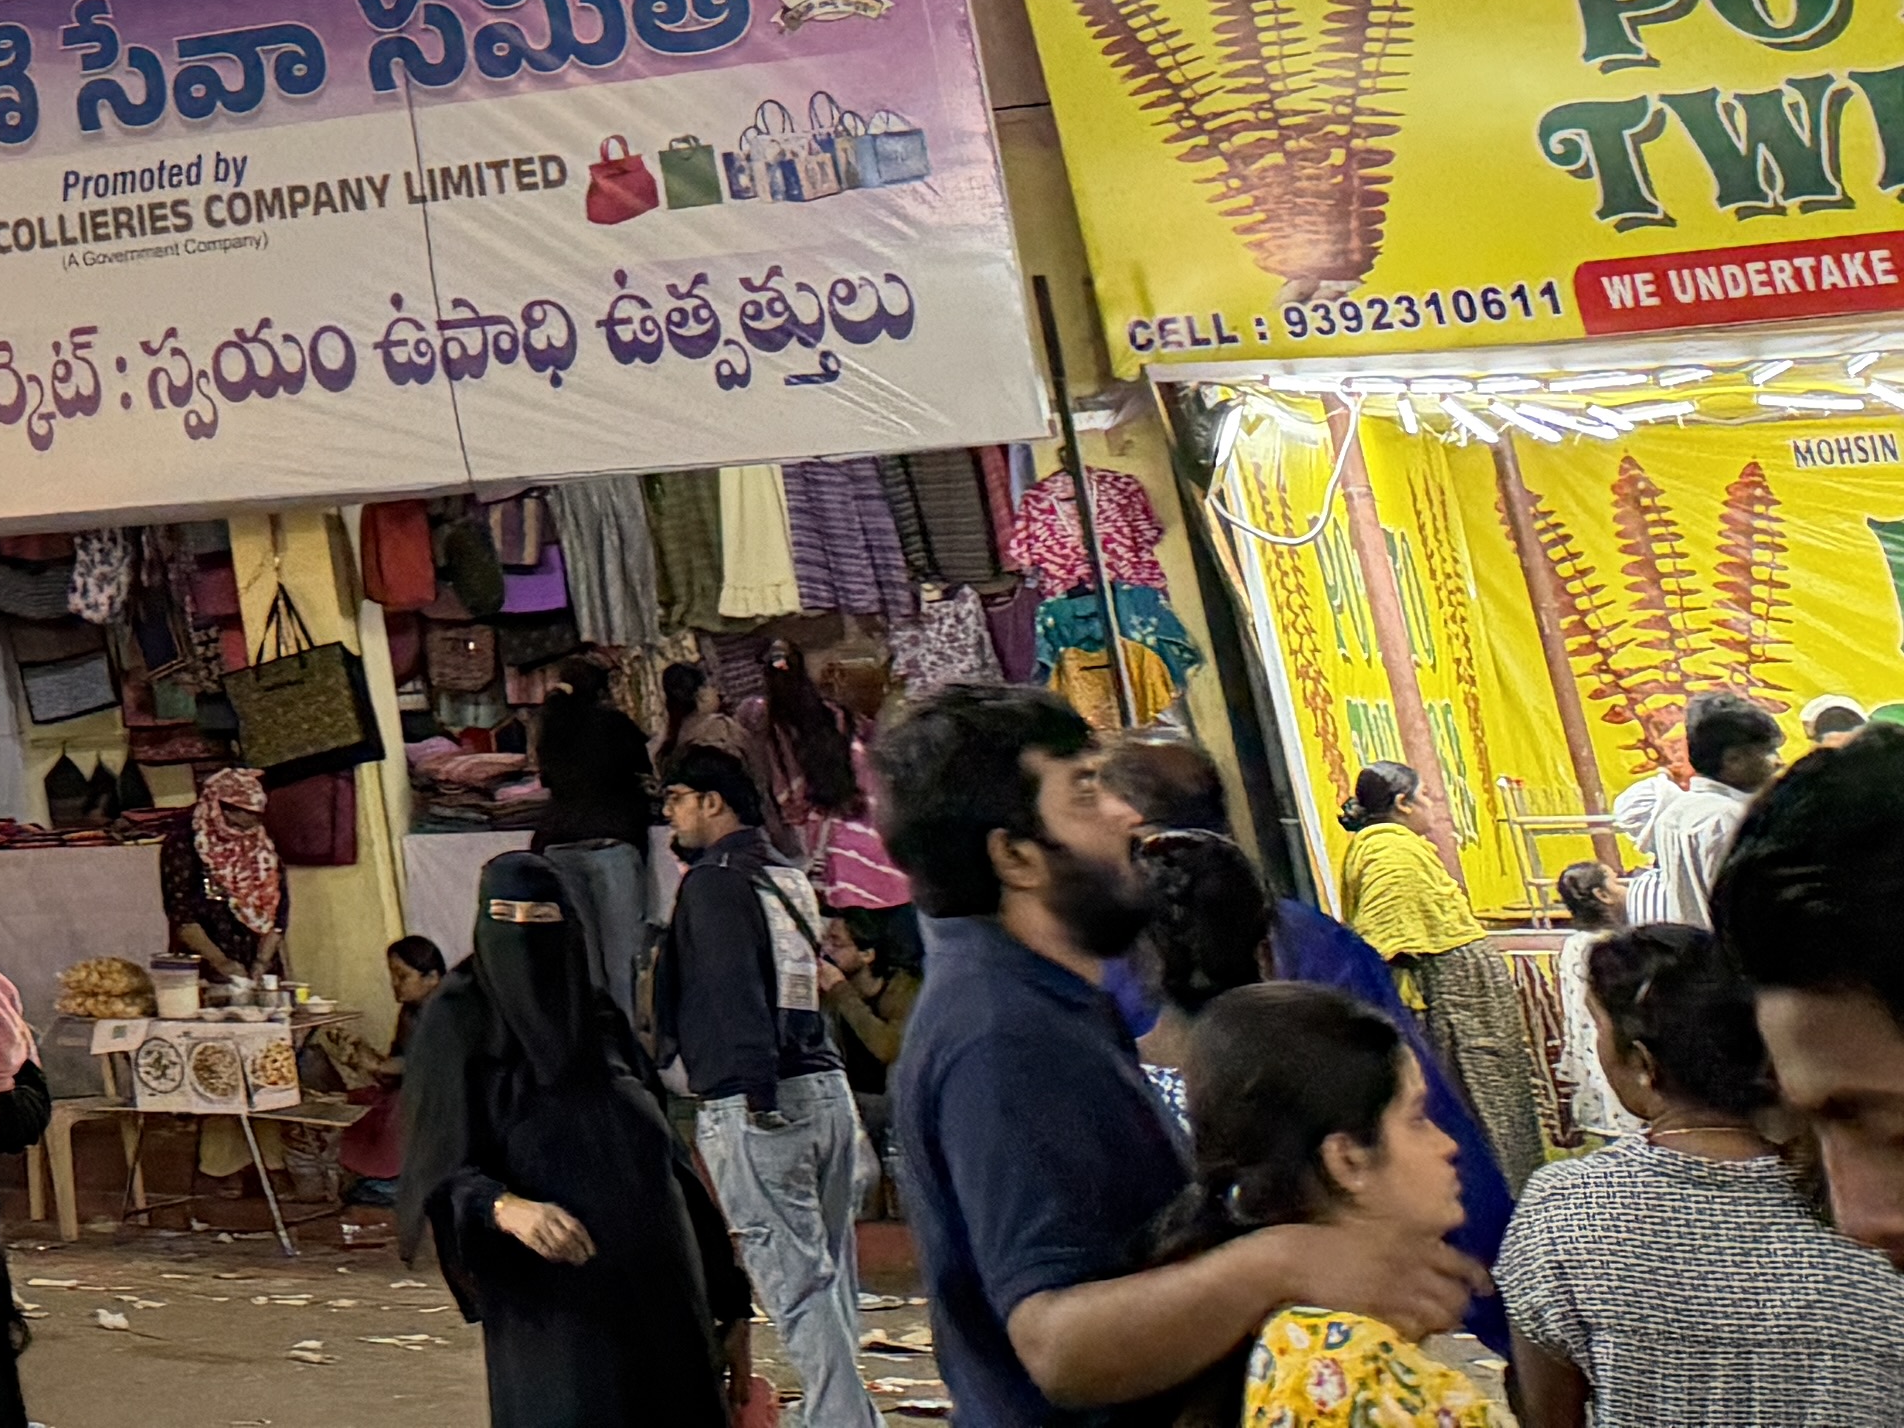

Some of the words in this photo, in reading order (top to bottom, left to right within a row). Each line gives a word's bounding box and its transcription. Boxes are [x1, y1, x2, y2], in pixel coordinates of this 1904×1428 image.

[62, 155, 203, 203] Promoted
[213, 150, 248, 192] by
[204, 174, 392, 230] COMPANY
[404, 152, 569, 208] LIMITED
[84, 242, 179, 270] Government
[183, 230, 269, 259] Company)
[1600, 271, 1661, 310] WE
[1667, 249, 1900, 305] UNDERTAKE
[1127, 314, 1240, 355] CELL
[1283, 279, 1564, 341] 9392310611
[143, 316, 356, 441] స్వయం
[373, 293, 578, 387] ఉపాధి
[596, 265, 915, 391] ఉత్పత్తులు
[1792, 433, 1900, 469] MOHSIN
